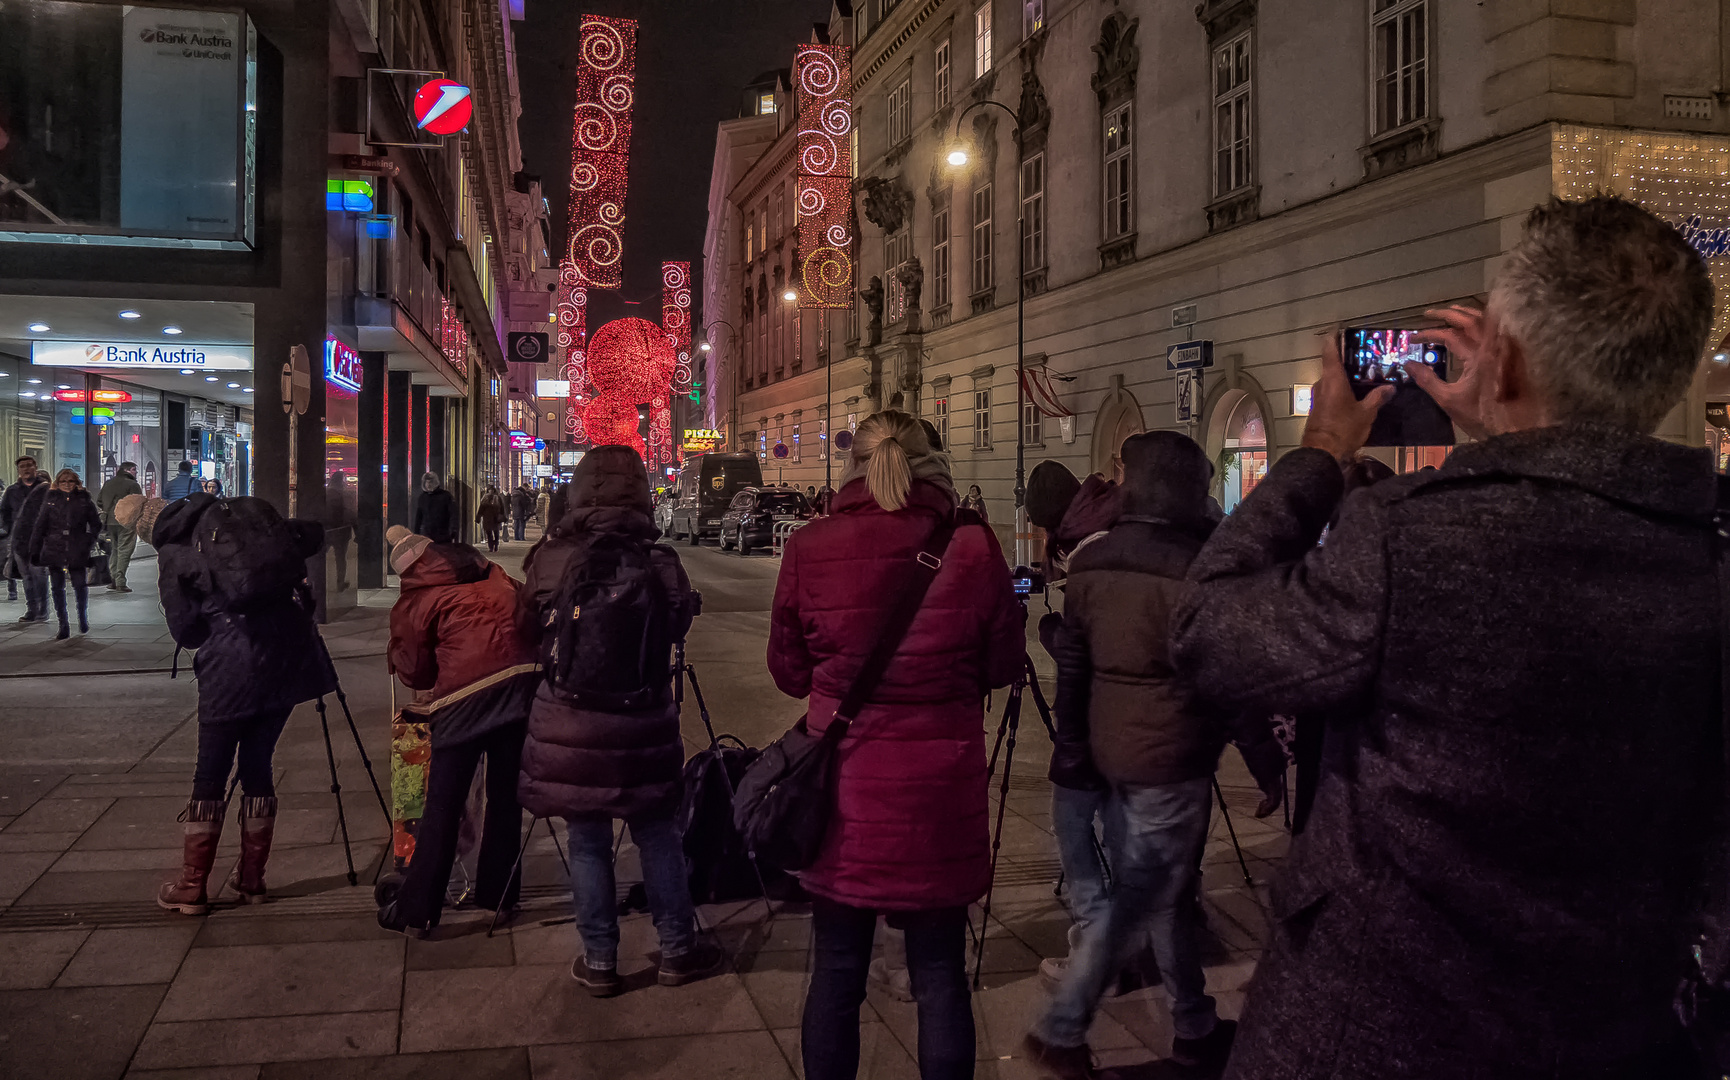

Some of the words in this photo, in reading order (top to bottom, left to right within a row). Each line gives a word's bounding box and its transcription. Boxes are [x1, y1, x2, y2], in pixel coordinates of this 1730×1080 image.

[156, 30, 188, 45] Bank
[190, 33, 232, 48] Austria
[193, 50, 231, 60] UniCredit
[361, 158, 394, 169] Banking
[107, 346, 148, 363] Bank
[151, 347, 206, 364] Austria
[1177, 348, 1199, 362] EINBAHN
[684, 429, 720, 439] PIZZA
